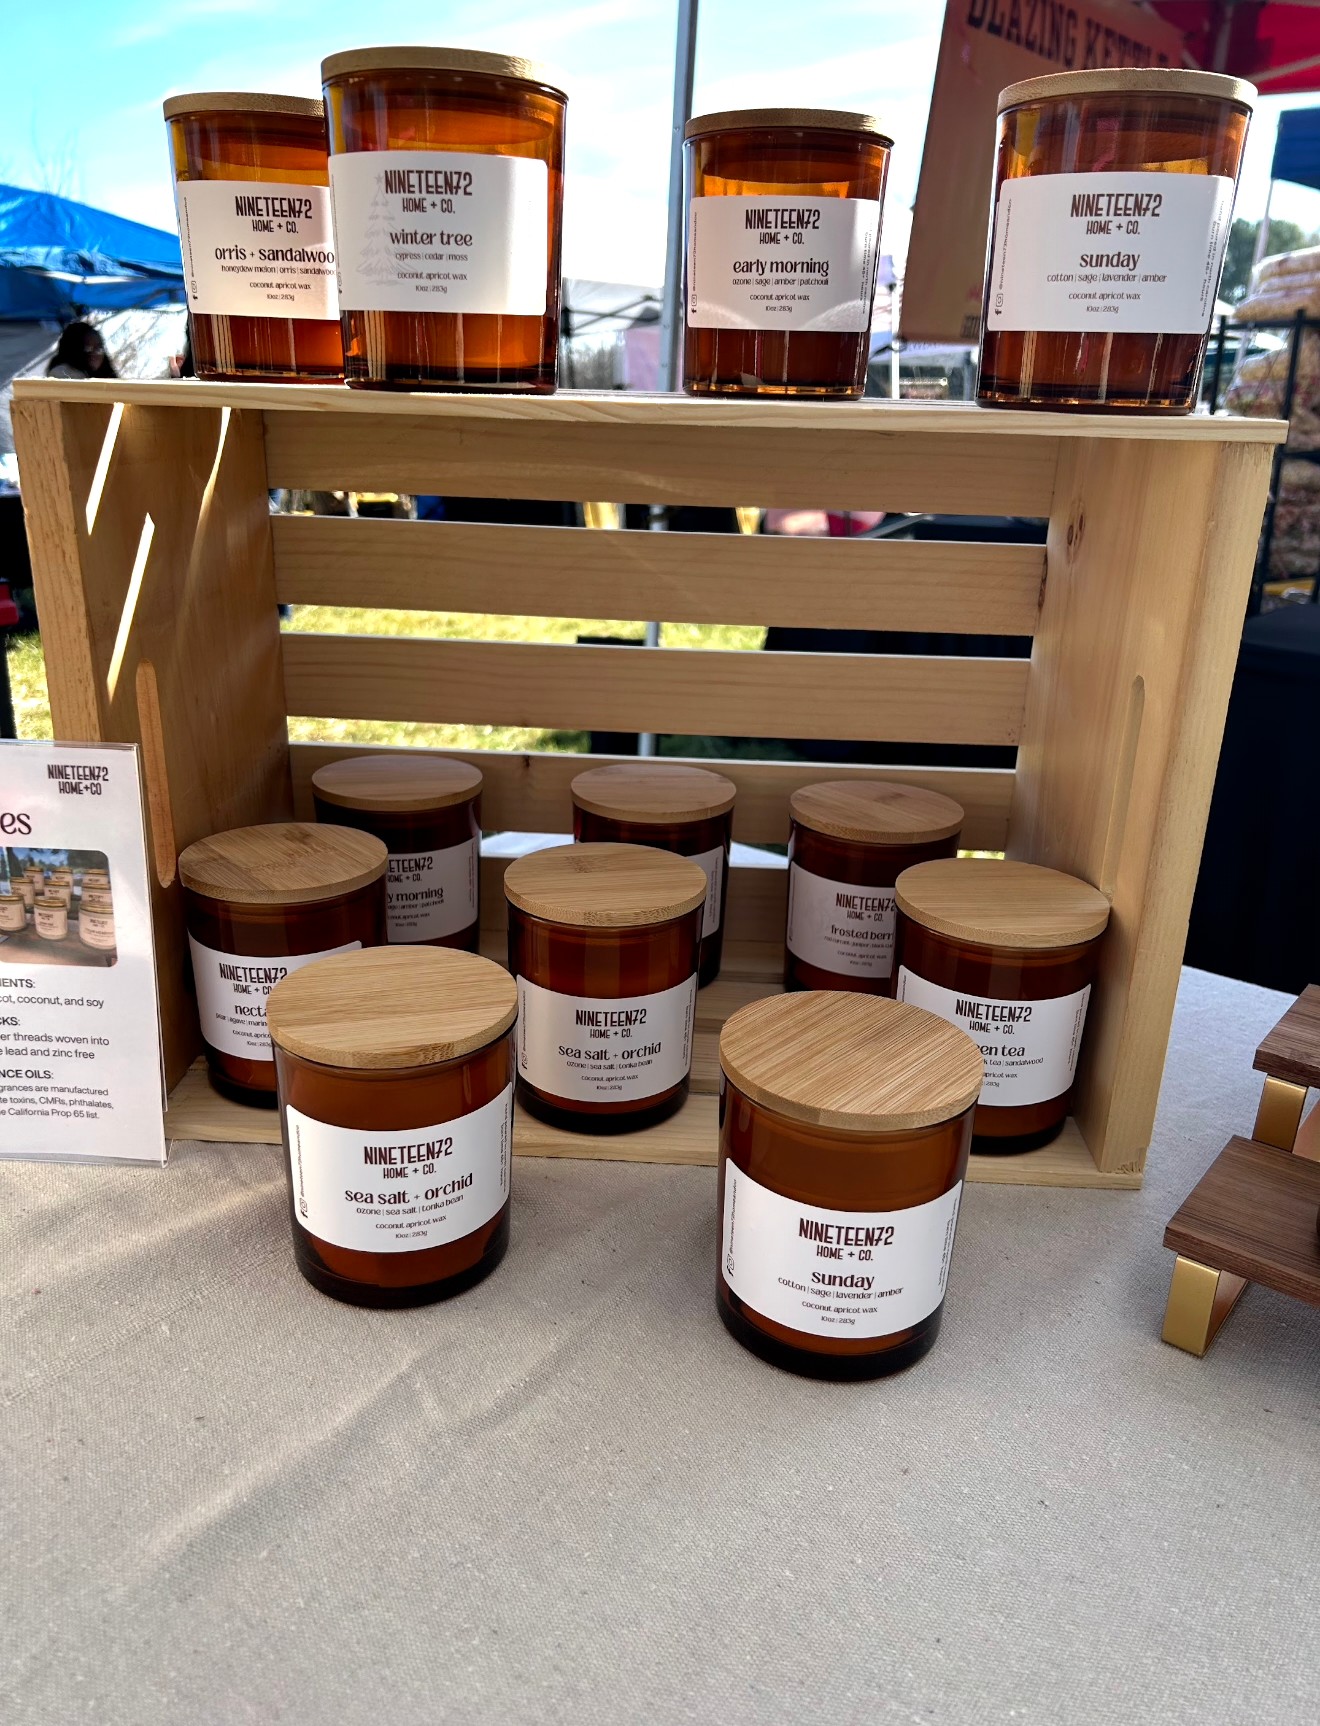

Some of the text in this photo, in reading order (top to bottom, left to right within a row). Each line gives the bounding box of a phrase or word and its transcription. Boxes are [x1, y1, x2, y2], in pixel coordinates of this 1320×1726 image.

[384, 170, 473, 196] NINETEEN72
[235, 196, 312, 219] NINETEEN72
[402, 198, 427, 213] HOME
[441, 199, 455, 214] CO.
[1071, 193, 1163, 217] NINETEEN72
[745, 209, 820, 230] NINETEEN72
[252, 220, 274, 233] HOME
[286, 221, 299, 234] CO.
[1086, 221, 1140, 235] HOME + CO.
[390, 229, 473, 246] winter tree
[760, 232, 780, 245] HOME
[793, 232, 805, 245] CO.
[215, 245, 247, 260] orris
[395, 252, 421, 261] cypress
[425, 253, 444, 261] cedar
[733, 258, 829, 277] early morning
[1079, 251, 1140, 271] sunday
[221, 265, 253, 273] honeydew
[280, 266, 296, 274] orris
[397, 272, 468, 281] coconut apricot wax
[732, 278, 829, 287] ozone sage amber patchouli
[1047, 273, 1167, 284] cotton sage lavender amber
[750, 293, 774, 301] coconut
[775, 294, 796, 302] apricot
[1069, 291, 1141, 301] coconut apricot wax
[47, 764, 109, 782] NINETEEN72
[59, 781, 102, 795] HOME+CO
[396, 887, 444, 901] morning
[847, 911, 864, 920] HOME
[831, 925, 868, 940] frosted
[233, 983, 252, 995] HOME
[17, 996, 104, 1009] coconut, and soy
[575, 1009, 647, 1027] NINETEEN72
[956, 999, 1032, 1023] NINETEEN72
[590, 1029, 610, 1039] HOME
[621, 1029, 632, 1038] CO.
[969, 1021, 991, 1033] HOME
[1003, 1024, 1015, 1035] CO.
[13, 1033, 110, 1046] threads woven into
[5, 1047, 28, 1056] lead
[30, 1047, 51, 1056] and
[52, 1049, 73, 1057] zinc
[75, 1049, 95, 1059] free
[559, 1045, 581, 1059] sea
[584, 1049, 610, 1061] salt
[622, 1042, 662, 1060] orchid
[1002, 1043, 1026, 1057] tea
[566, 1061, 587, 1069] ozone
[619, 1061, 637, 1069] tonka
[1005, 1058, 1044, 1067] sandalwood
[25, 1070, 54, 1079] OILS:
[605, 1075, 626, 1083] apricot
[51, 1086, 109, 1096] manufactured
[10, 1097, 38, 1105] toxins,
[39, 1097, 68, 1106] CMRs,
[69, 1098, 114, 1109] phthalates,
[8, 1108, 50, 1116] California
[51, 1109, 72, 1118] Prop
[74, 1110, 85, 1118] 65
[86, 1111, 100, 1119] list.
[364, 1137, 453, 1166] NINETEEN72
[383, 1166, 409, 1179] HOME
[423, 1163, 436, 1174] CO.
[345, 1190, 374, 1204] sea
[378, 1190, 410, 1205] salt
[425, 1173, 473, 1200] orchid
[356, 1207, 381, 1216] ozone
[402, 1206, 417, 1215] salt
[422, 1202, 445, 1212] tonka
[446, 1194, 464, 1206] bean
[375, 1215, 447, 1229] coconut apricot wax
[799, 1218, 895, 1247] NINETEEN72
[817, 1245, 844, 1260] HOME
[858, 1249, 873, 1261] CO.
[811, 1271, 874, 1291] sunday
[778, 1277, 903, 1300] cotton sage lavender amber
[802, 1301, 833, 1311] coconut
[834, 1306, 861, 1314] apricot
